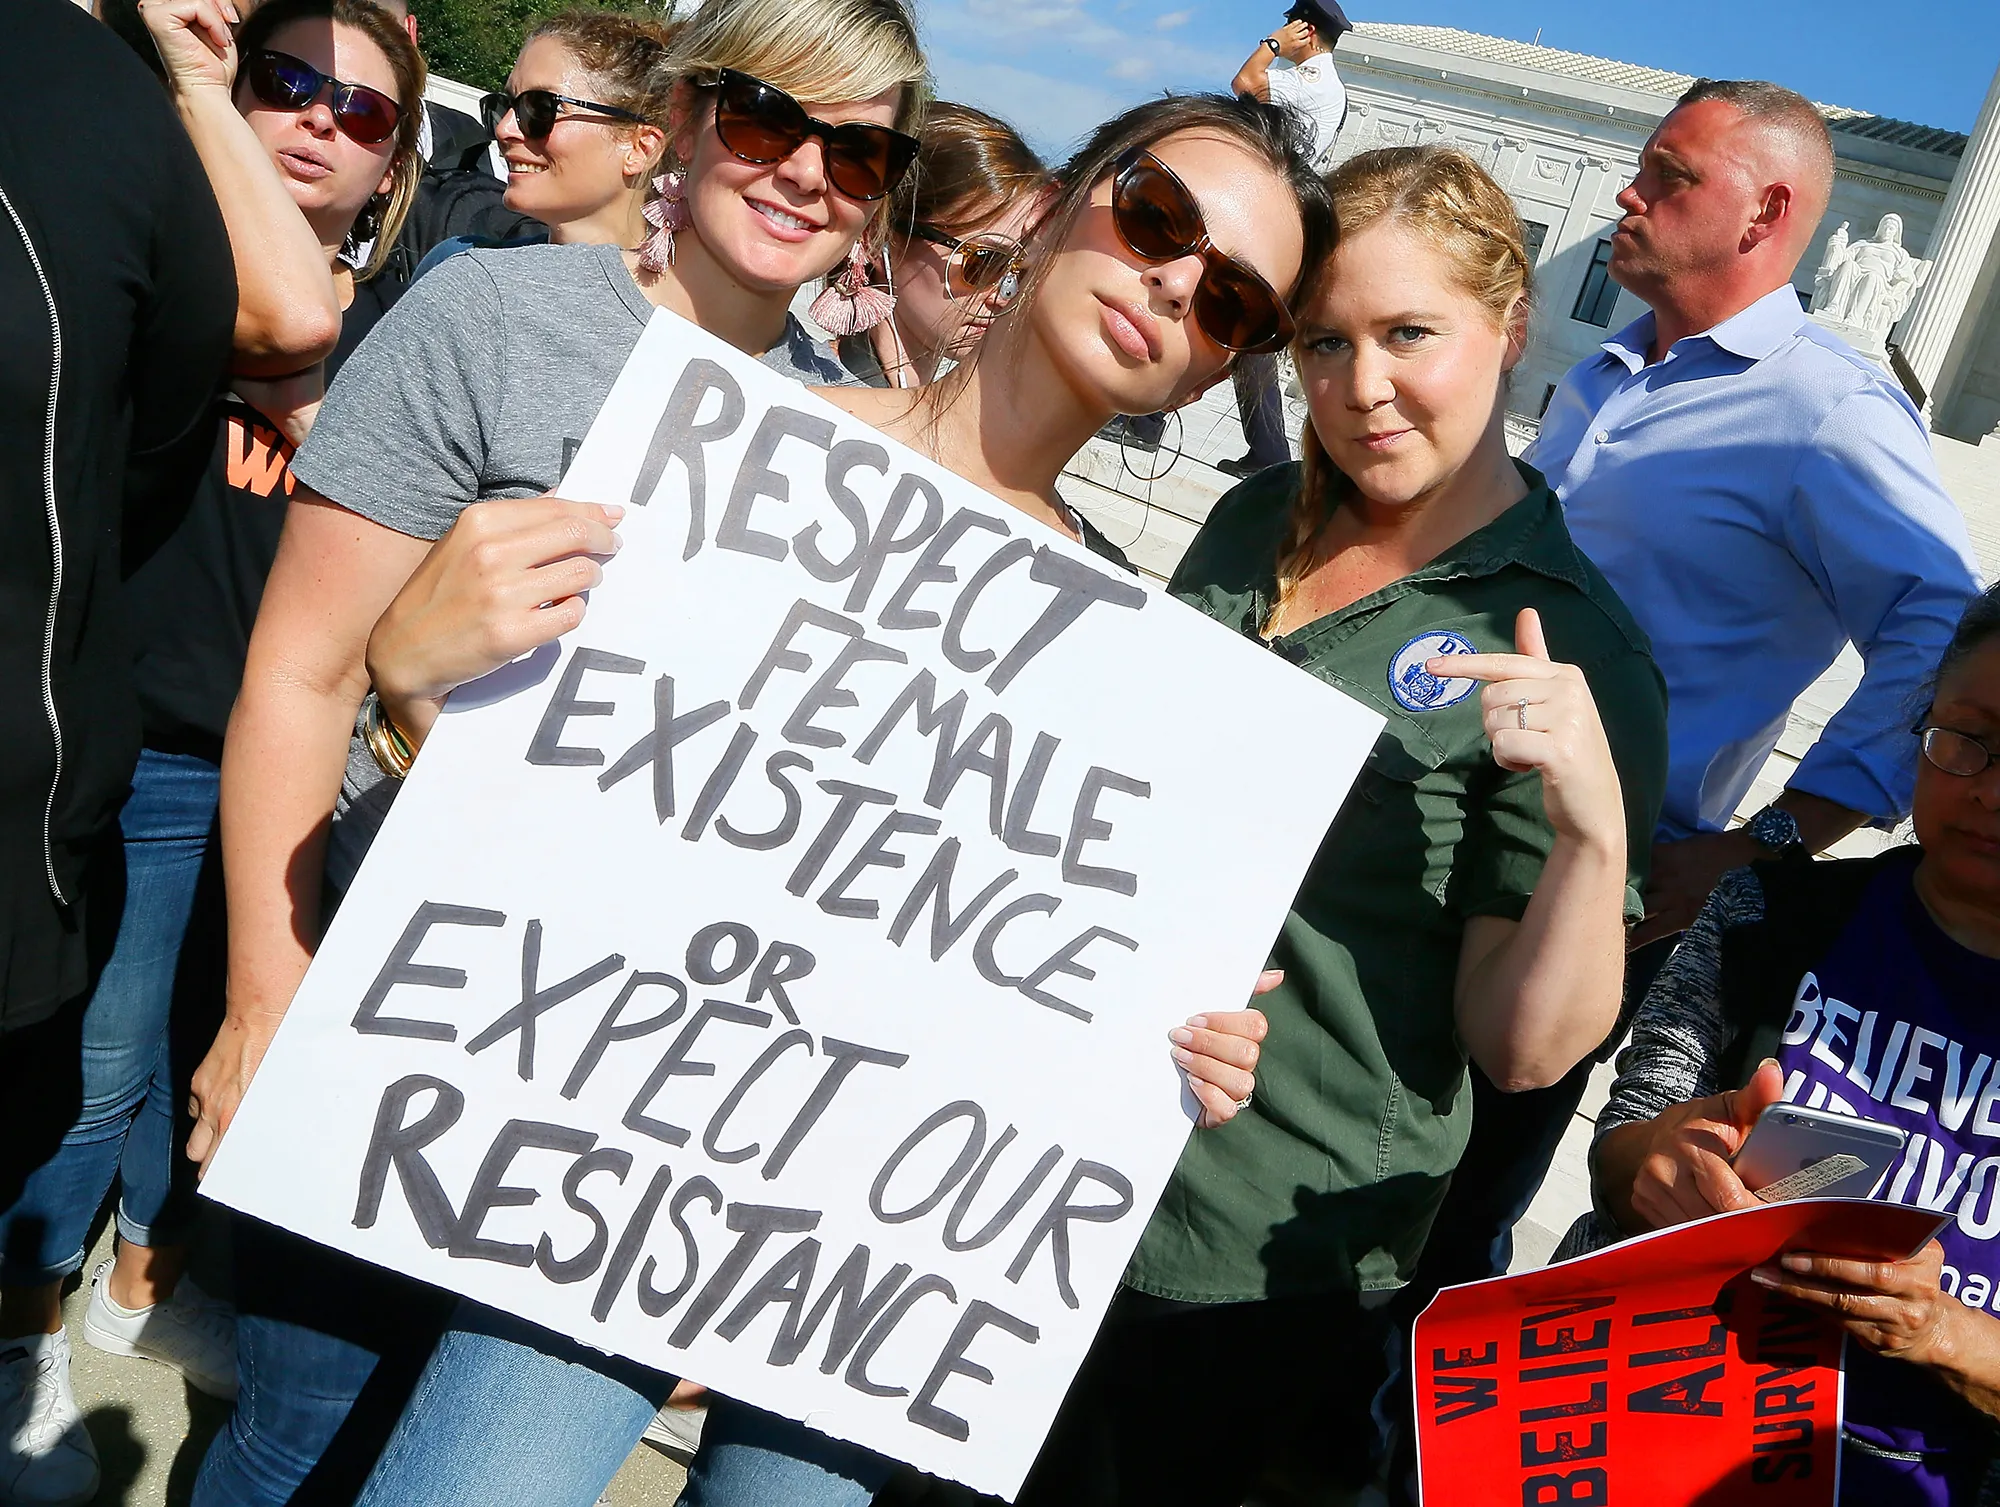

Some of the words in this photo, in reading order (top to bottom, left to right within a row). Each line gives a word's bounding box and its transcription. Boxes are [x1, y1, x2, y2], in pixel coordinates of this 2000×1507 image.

[630, 358, 1147, 695] RESPECT
[526, 646, 1139, 1023] EXISTENCE
[738, 598, 1151, 897] FEMALE
[351, 900, 909, 1180] EXPECT
[869, 1100, 1134, 1310] OUR
[686, 922, 816, 1025] OR
[352, 1074, 1040, 1442] RESISTANCE
[1433, 1341, 1498, 1426] WE
[1627, 1288, 1736, 1417] ALL
